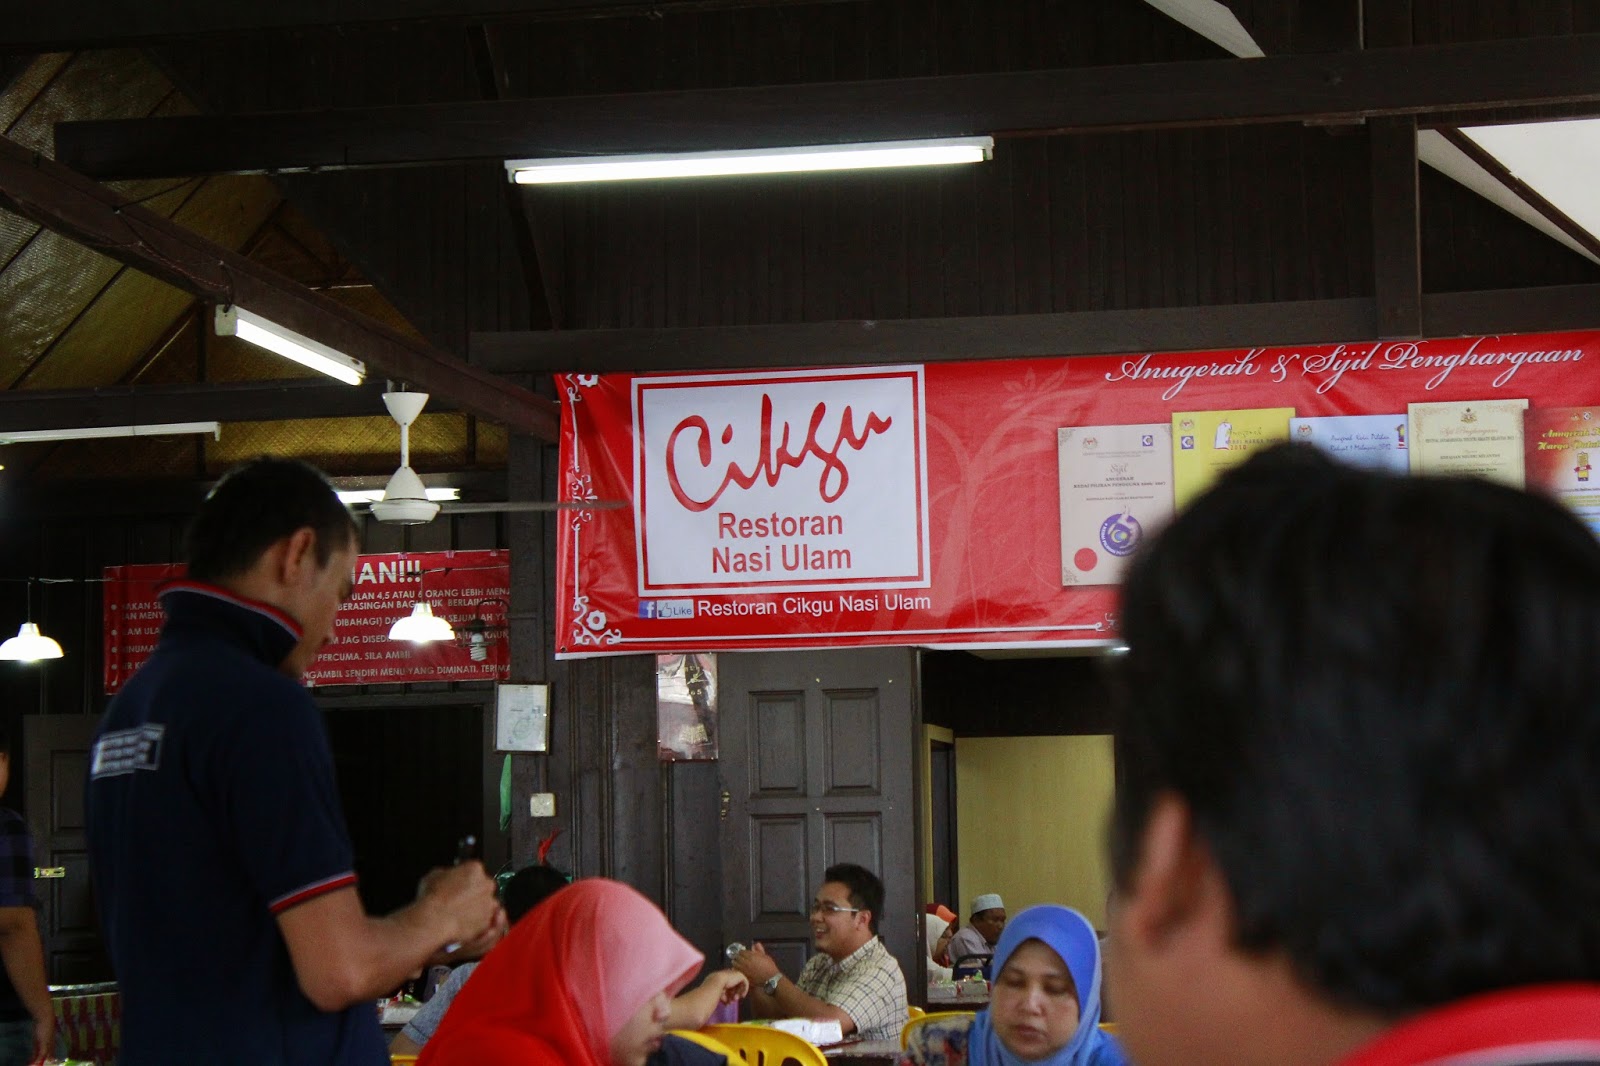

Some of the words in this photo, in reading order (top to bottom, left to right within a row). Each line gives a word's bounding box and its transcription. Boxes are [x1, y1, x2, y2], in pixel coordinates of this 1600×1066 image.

[1105, 348, 1265, 401] Anugerah
[1270, 354, 1300, 383] &
[1301, 342, 1383, 394] Sijil
[1378, 336, 1584, 390] Penghargaan
[665, 393, 893, 513] Cikgu
[718, 512, 843, 539] Restoran
[711, 545, 771, 574] Nasi
[781, 543, 852, 571] Ulam
[123, 602, 151, 611] AKAN
[351, 592, 375, 601] ULAN
[377, 591, 391, 600] 4,5
[392, 590, 415, 599] ATAU
[425, 588, 458, 598] ORANG
[461, 588, 484, 597] LEBIH
[337, 601, 394, 611] BERASINGAN
[673, 606, 693, 616] Like
[697, 602, 777, 617] Restoran
[782, 597, 833, 616] Cikgu
[839, 595, 880, 612] Nasi
[884, 593, 931, 610] Ulam
[144, 627, 163, 636] ULA
[335, 617, 382, 627] DIBAHAGI)
[341, 635, 360, 644] JAG
[317, 652, 363, 662] PERCUMA.
[364, 651, 383, 660] SILA
[385, 650, 411, 659] AMBIL
[302, 670, 343, 679] NGAMBIL
[345, 669, 378, 677] SENDIRI
[408, 665, 435, 675] YANG
[436, 664, 479, 674] DIMINATI.
